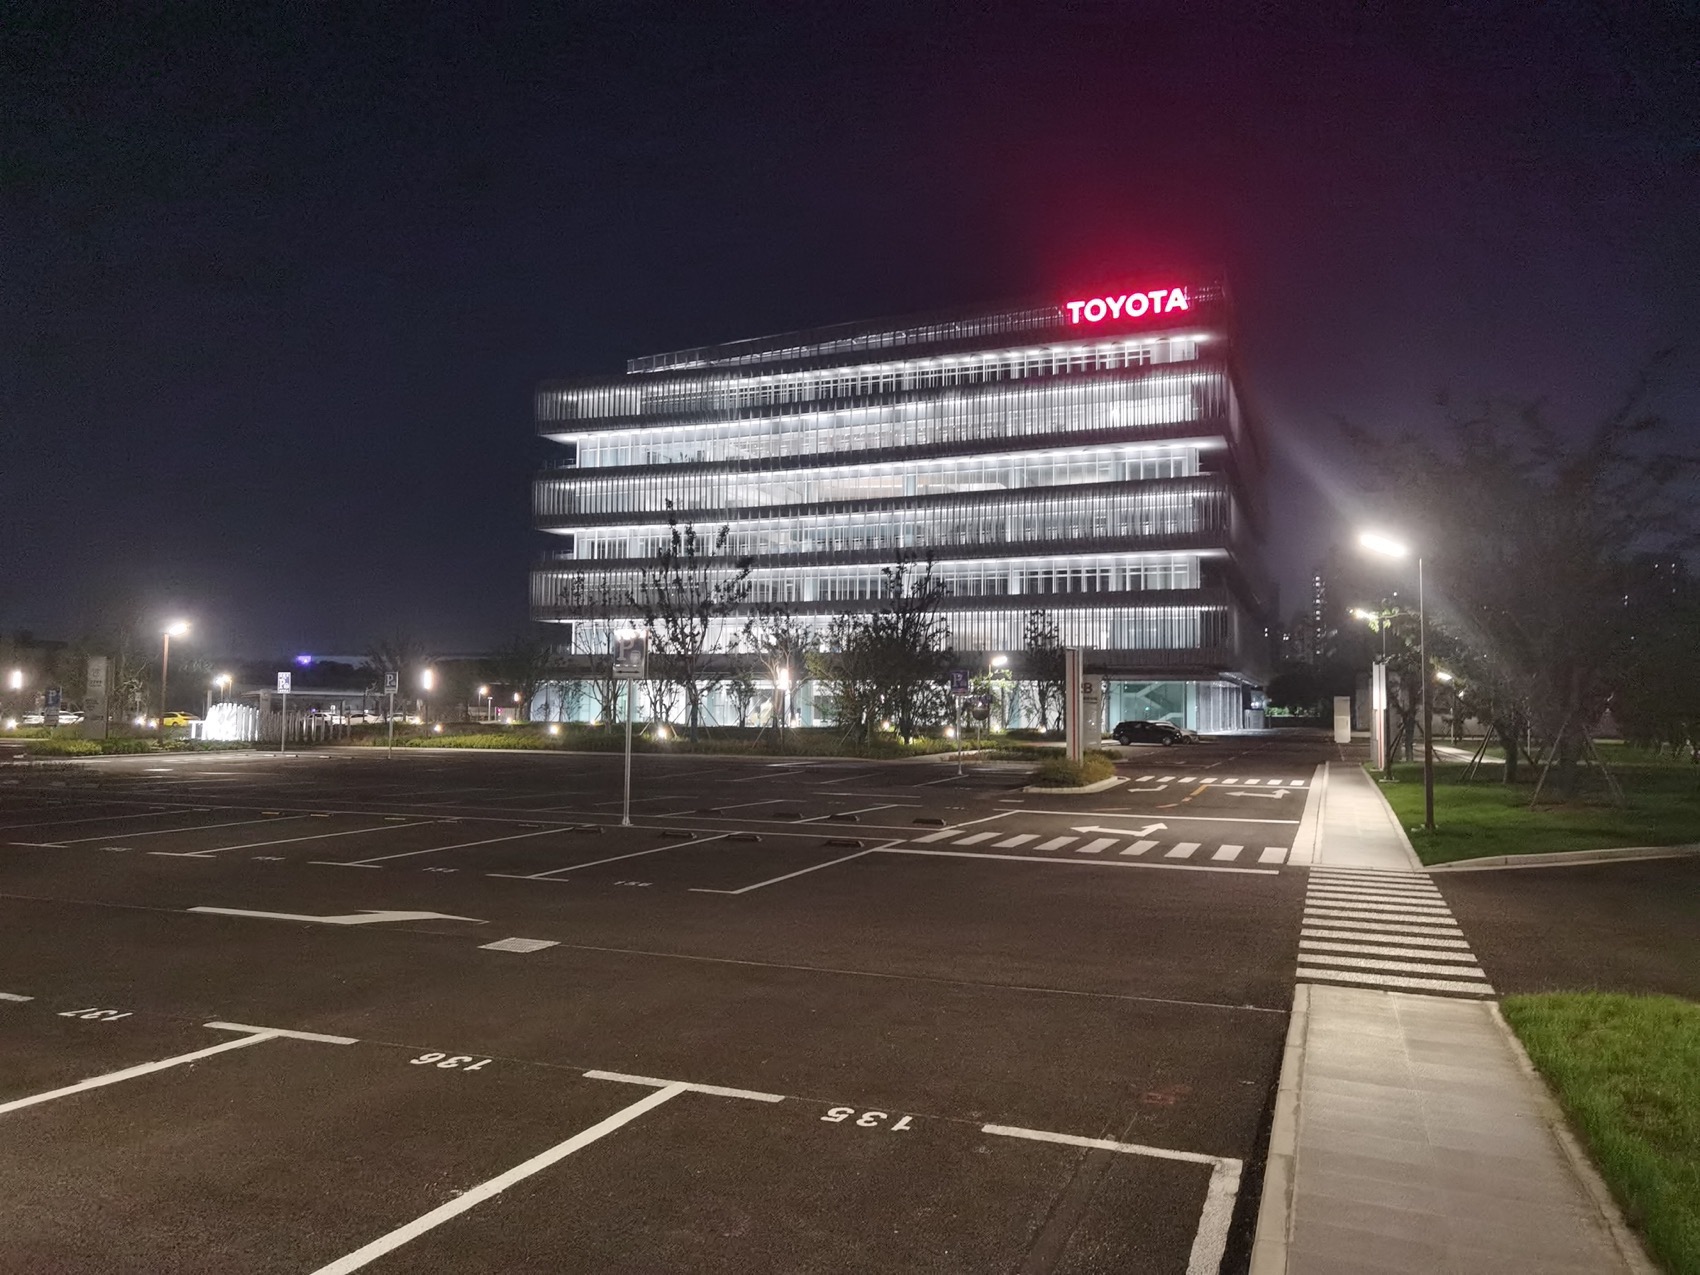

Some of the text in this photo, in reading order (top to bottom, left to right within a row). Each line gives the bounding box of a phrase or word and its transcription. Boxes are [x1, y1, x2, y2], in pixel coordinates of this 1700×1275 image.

[1067, 287, 1189, 325] TOYOTA
[57, 1007, 134, 1021] 137
[410, 1052, 493, 1071] 136
[820, 1107, 913, 1132] 135
